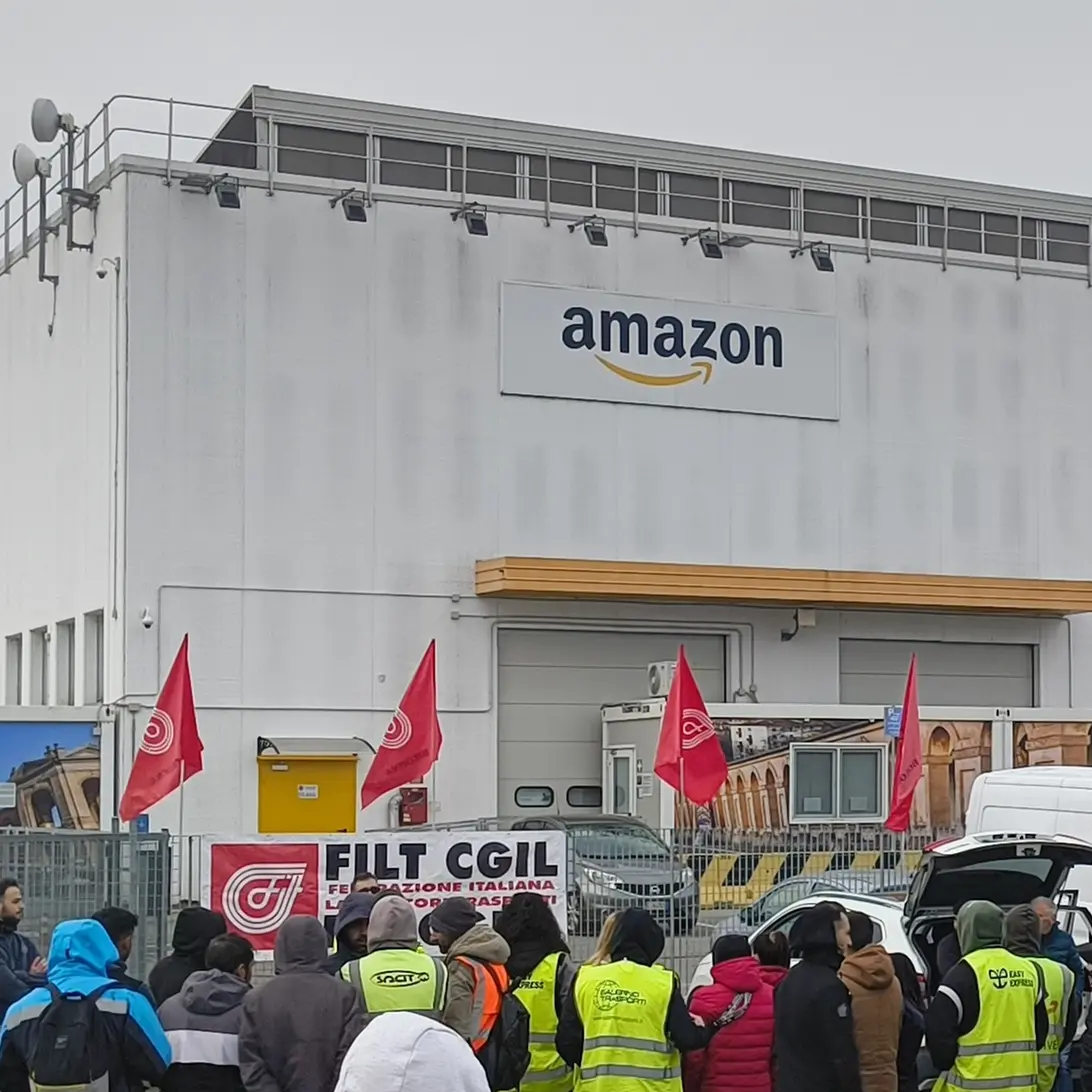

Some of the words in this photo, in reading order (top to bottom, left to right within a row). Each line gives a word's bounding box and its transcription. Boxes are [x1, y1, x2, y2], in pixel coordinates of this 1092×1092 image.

[562, 306, 783, 368] amazon
[326, 843, 427, 880] FILT
[446, 841, 558, 879] CGIL
[329, 882, 462, 894] FEAZIONE
[469, 880, 555, 891] ITALIANA
